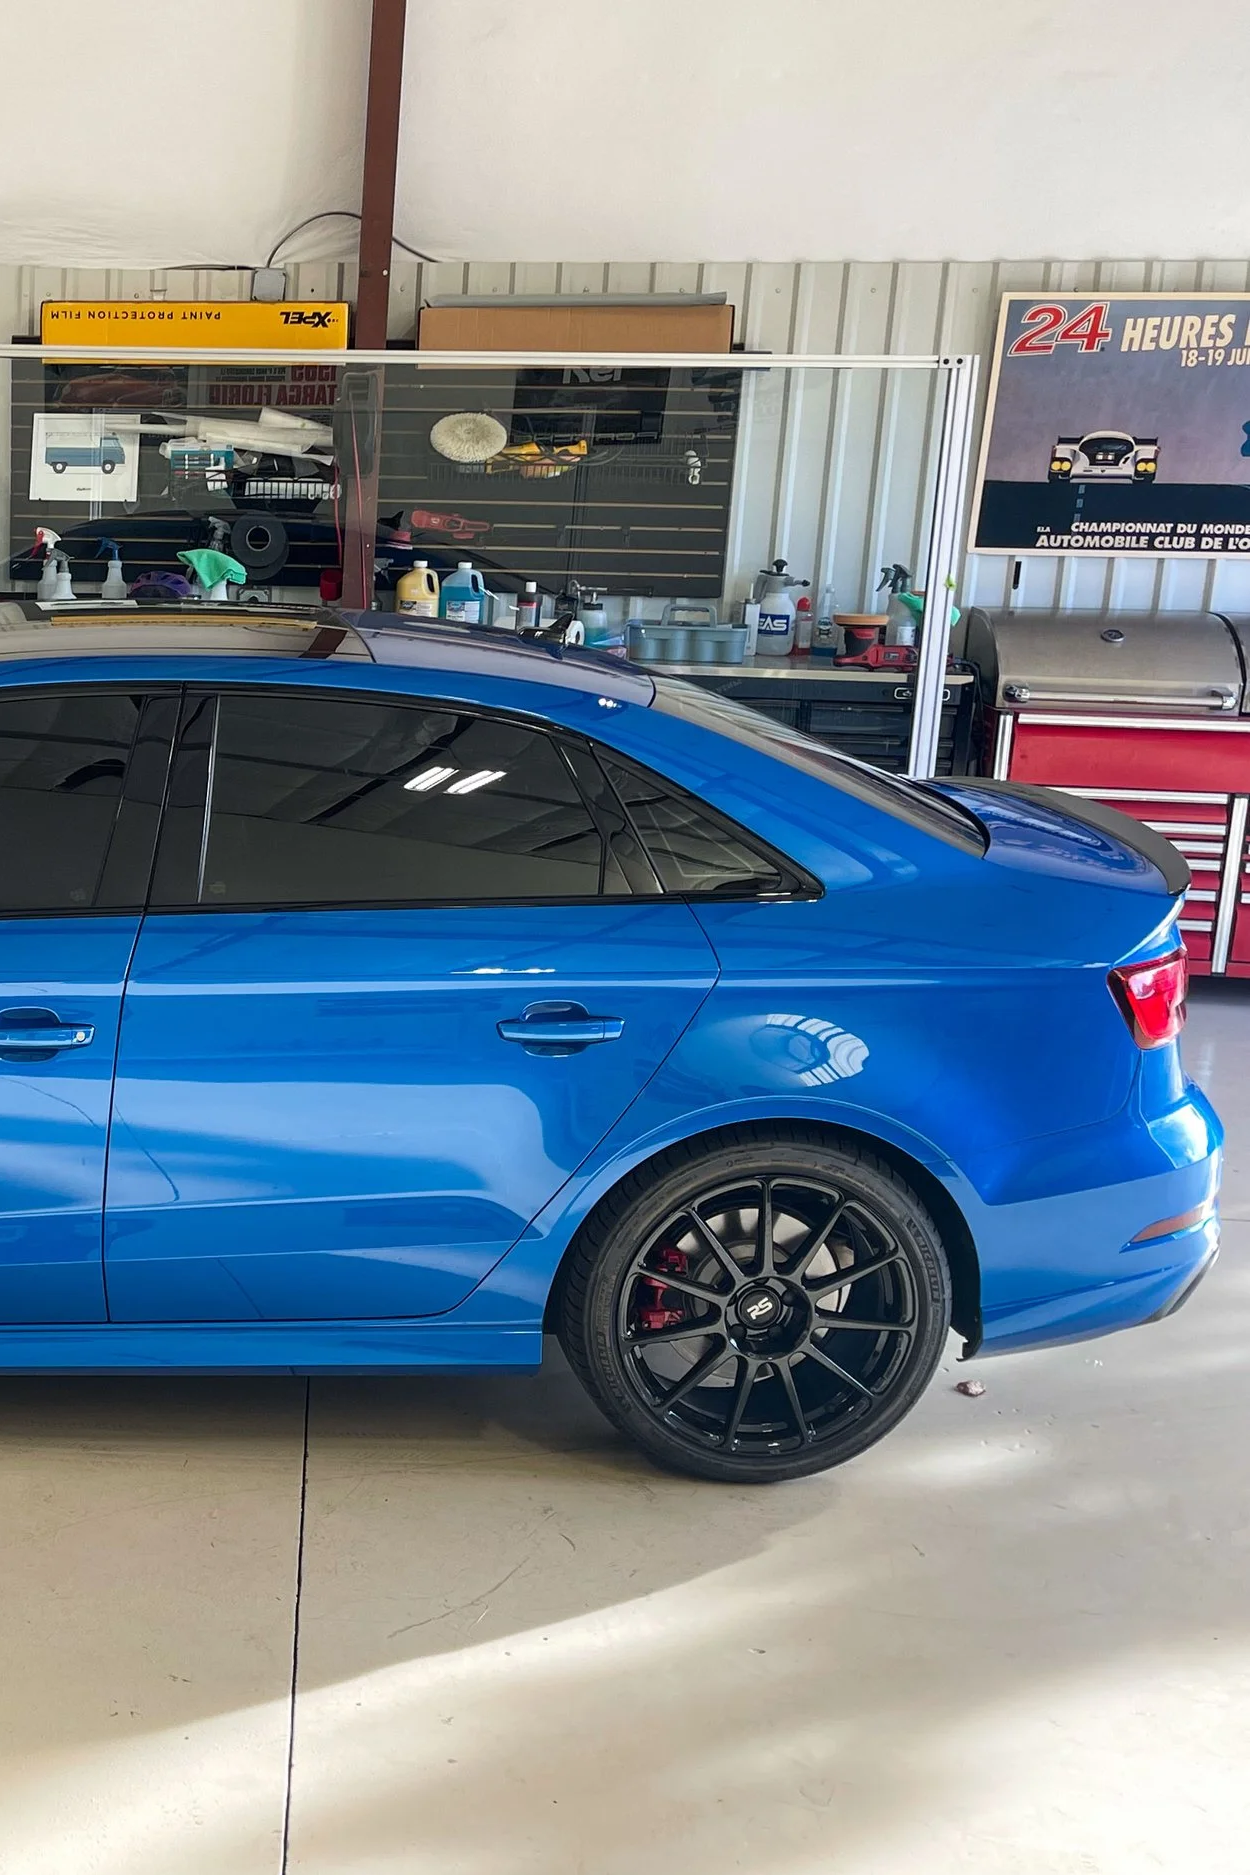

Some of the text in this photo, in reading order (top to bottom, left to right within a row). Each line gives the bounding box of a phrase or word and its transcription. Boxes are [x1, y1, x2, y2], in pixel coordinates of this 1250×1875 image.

[50, 311, 221, 320] PAINT PROTECTION FILM
[280, 311, 332, 328] XPEL
[1007, 302, 1113, 357] 24
[1120, 314, 1236, 352] HEURES
[1181, 348, 1225, 367] 18-19
[1071, 522, 1174, 534] CHAMPIONNAT
[1177, 524, 1197, 534] DU
[1200, 523, 1250, 535] MONDE
[1036, 535, 1149, 548] AUTOMOBILE
[1154, 536, 1195, 550] CLUB
[1200, 537, 1223, 550] DE
[747, 1297, 772, 1319] RS
